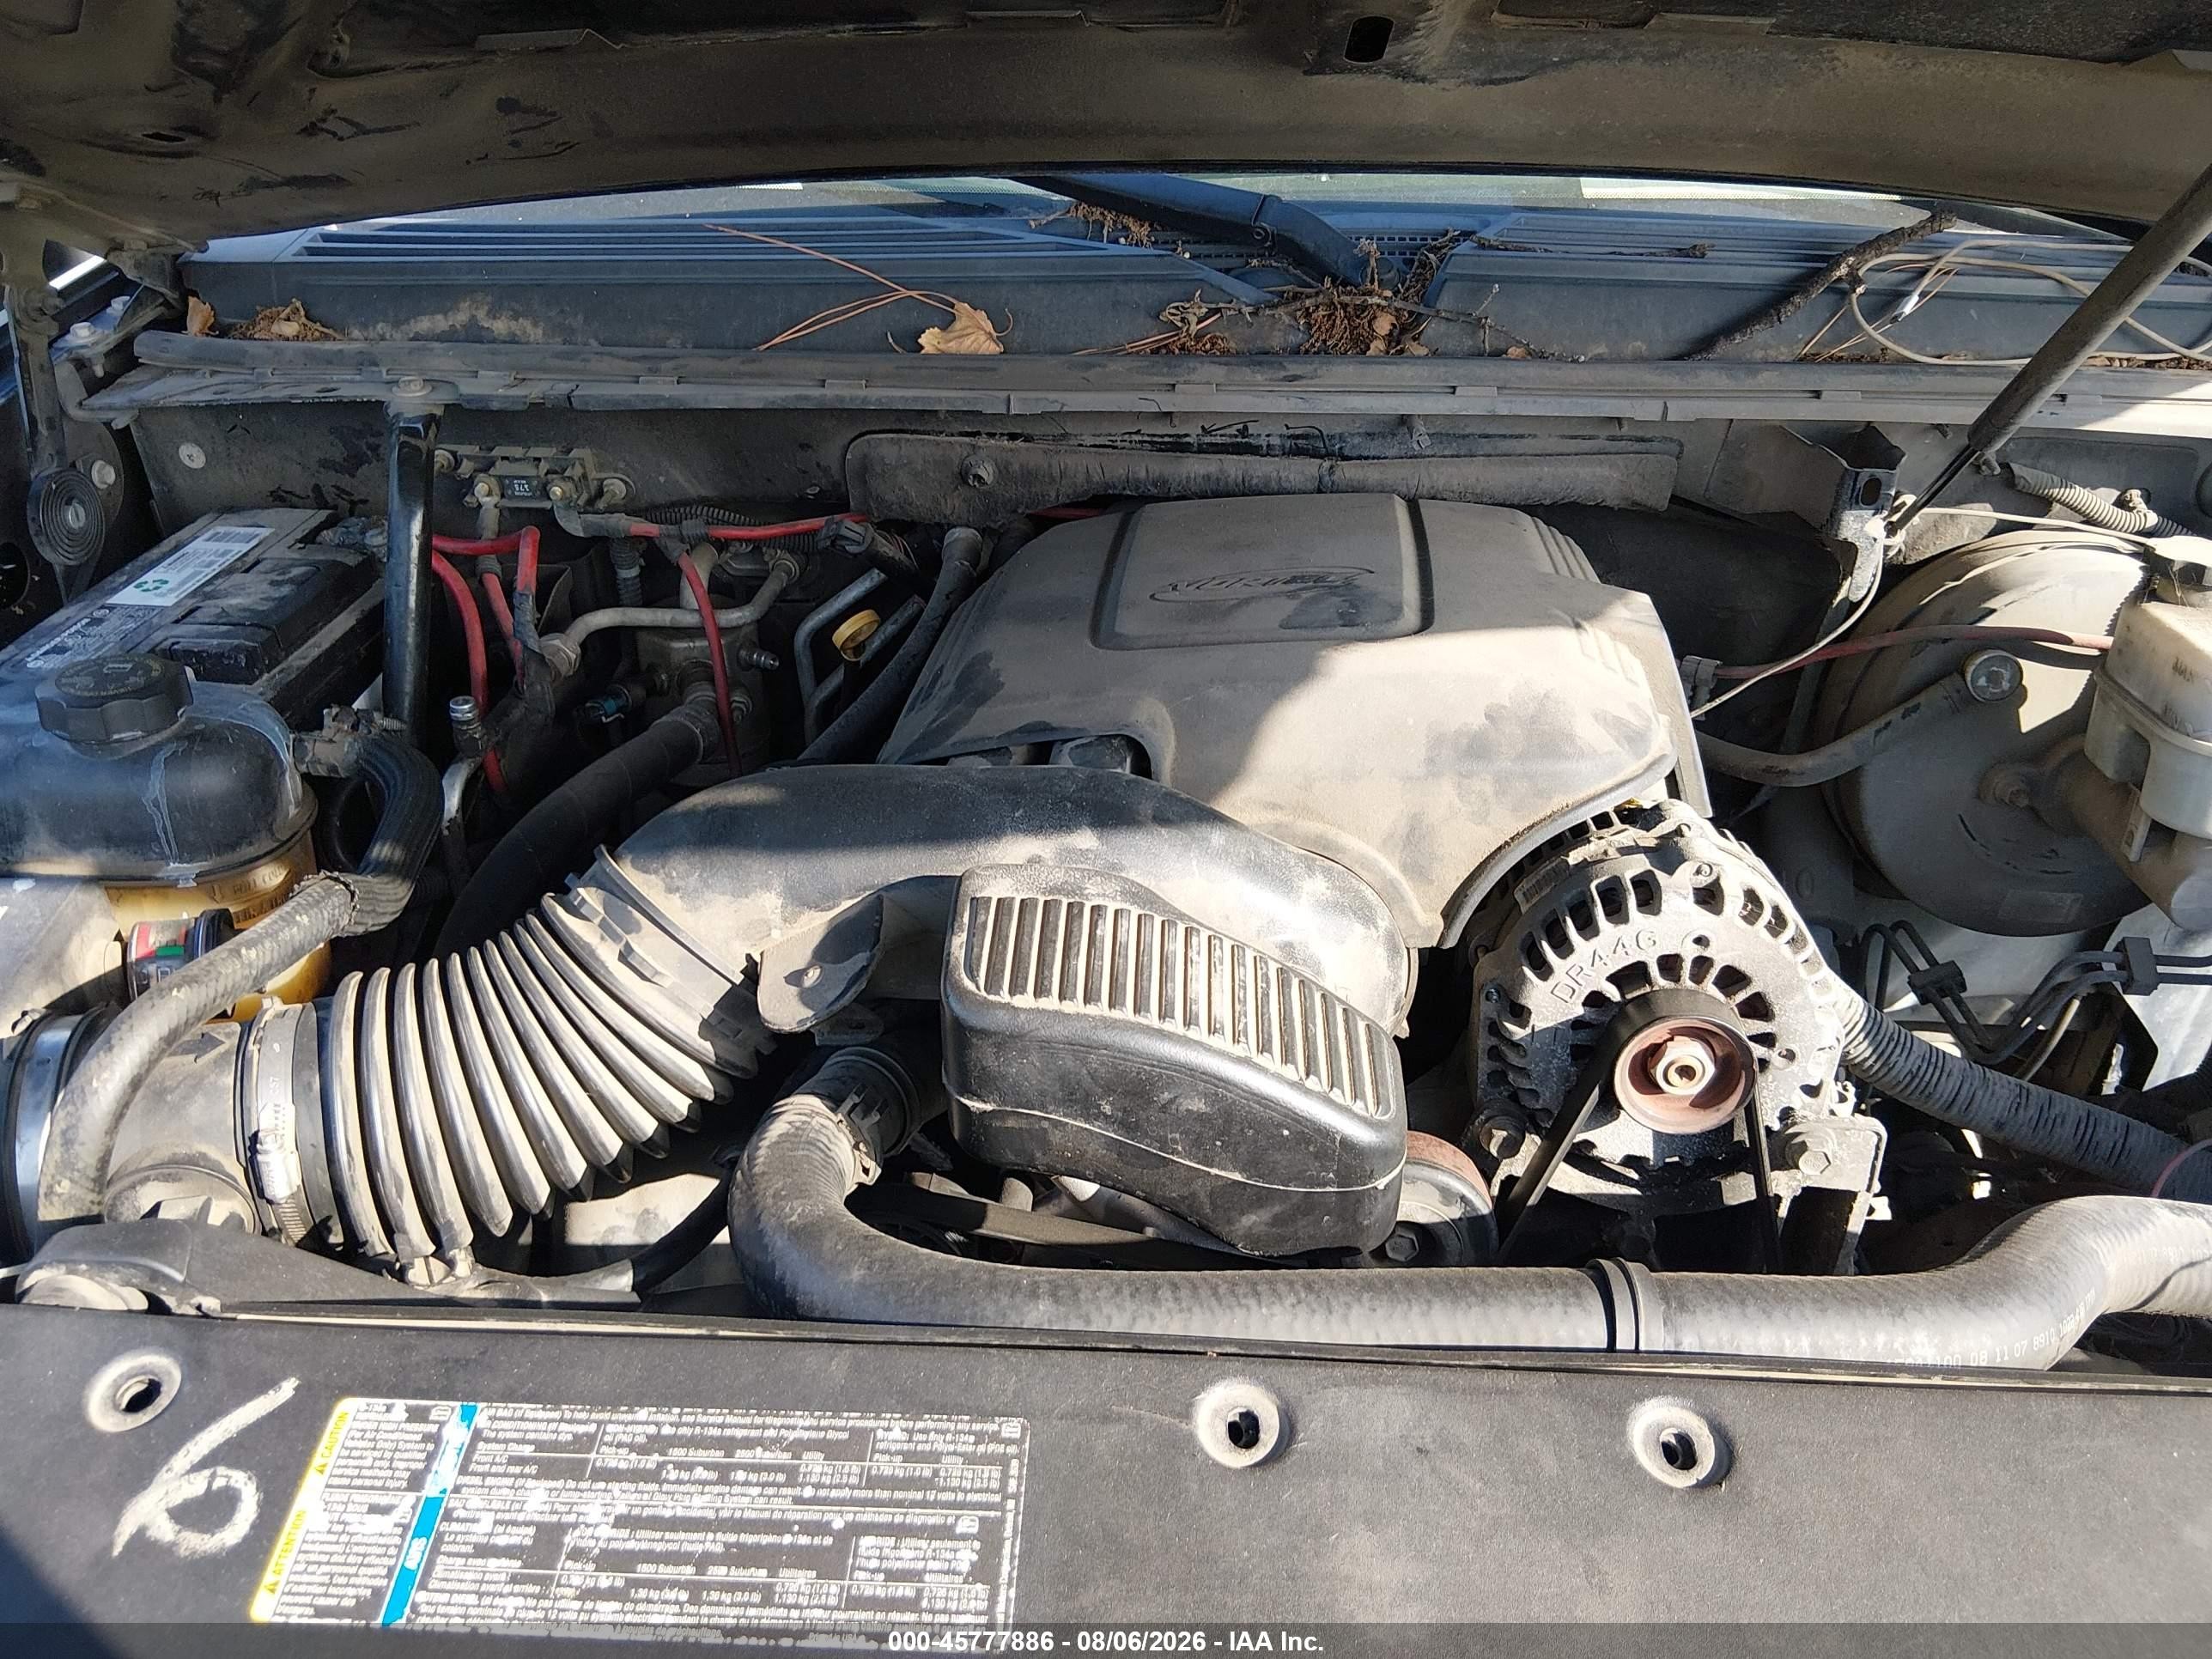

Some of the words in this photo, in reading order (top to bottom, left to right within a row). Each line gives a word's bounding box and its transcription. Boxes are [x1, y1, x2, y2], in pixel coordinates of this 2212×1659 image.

[1551, 929, 1656, 1003] DR44G
[1971, 1350, 1987, 1365] 08
[1996, 1346, 2008, 1362] 11
[2014, 1340, 2027, 1357] 07
[2033, 1330, 2055, 1351] 8910
[563, 1410, 574, 1419] To
[321, 1411, 349, 1458] CAUTION
[482, 1431, 496, 1439] The
[426, 1443, 434, 1451] to
[917, 1443, 931, 1451] and
[383, 1449, 392, 1459] by
[689, 1448, 725, 1457] Suburban
[493, 1455, 508, 1463] A/C
[112, 1376, 298, 1559] 6
[491, 1463, 507, 1472] and
[272, 1510, 307, 1575] ATTENTION
